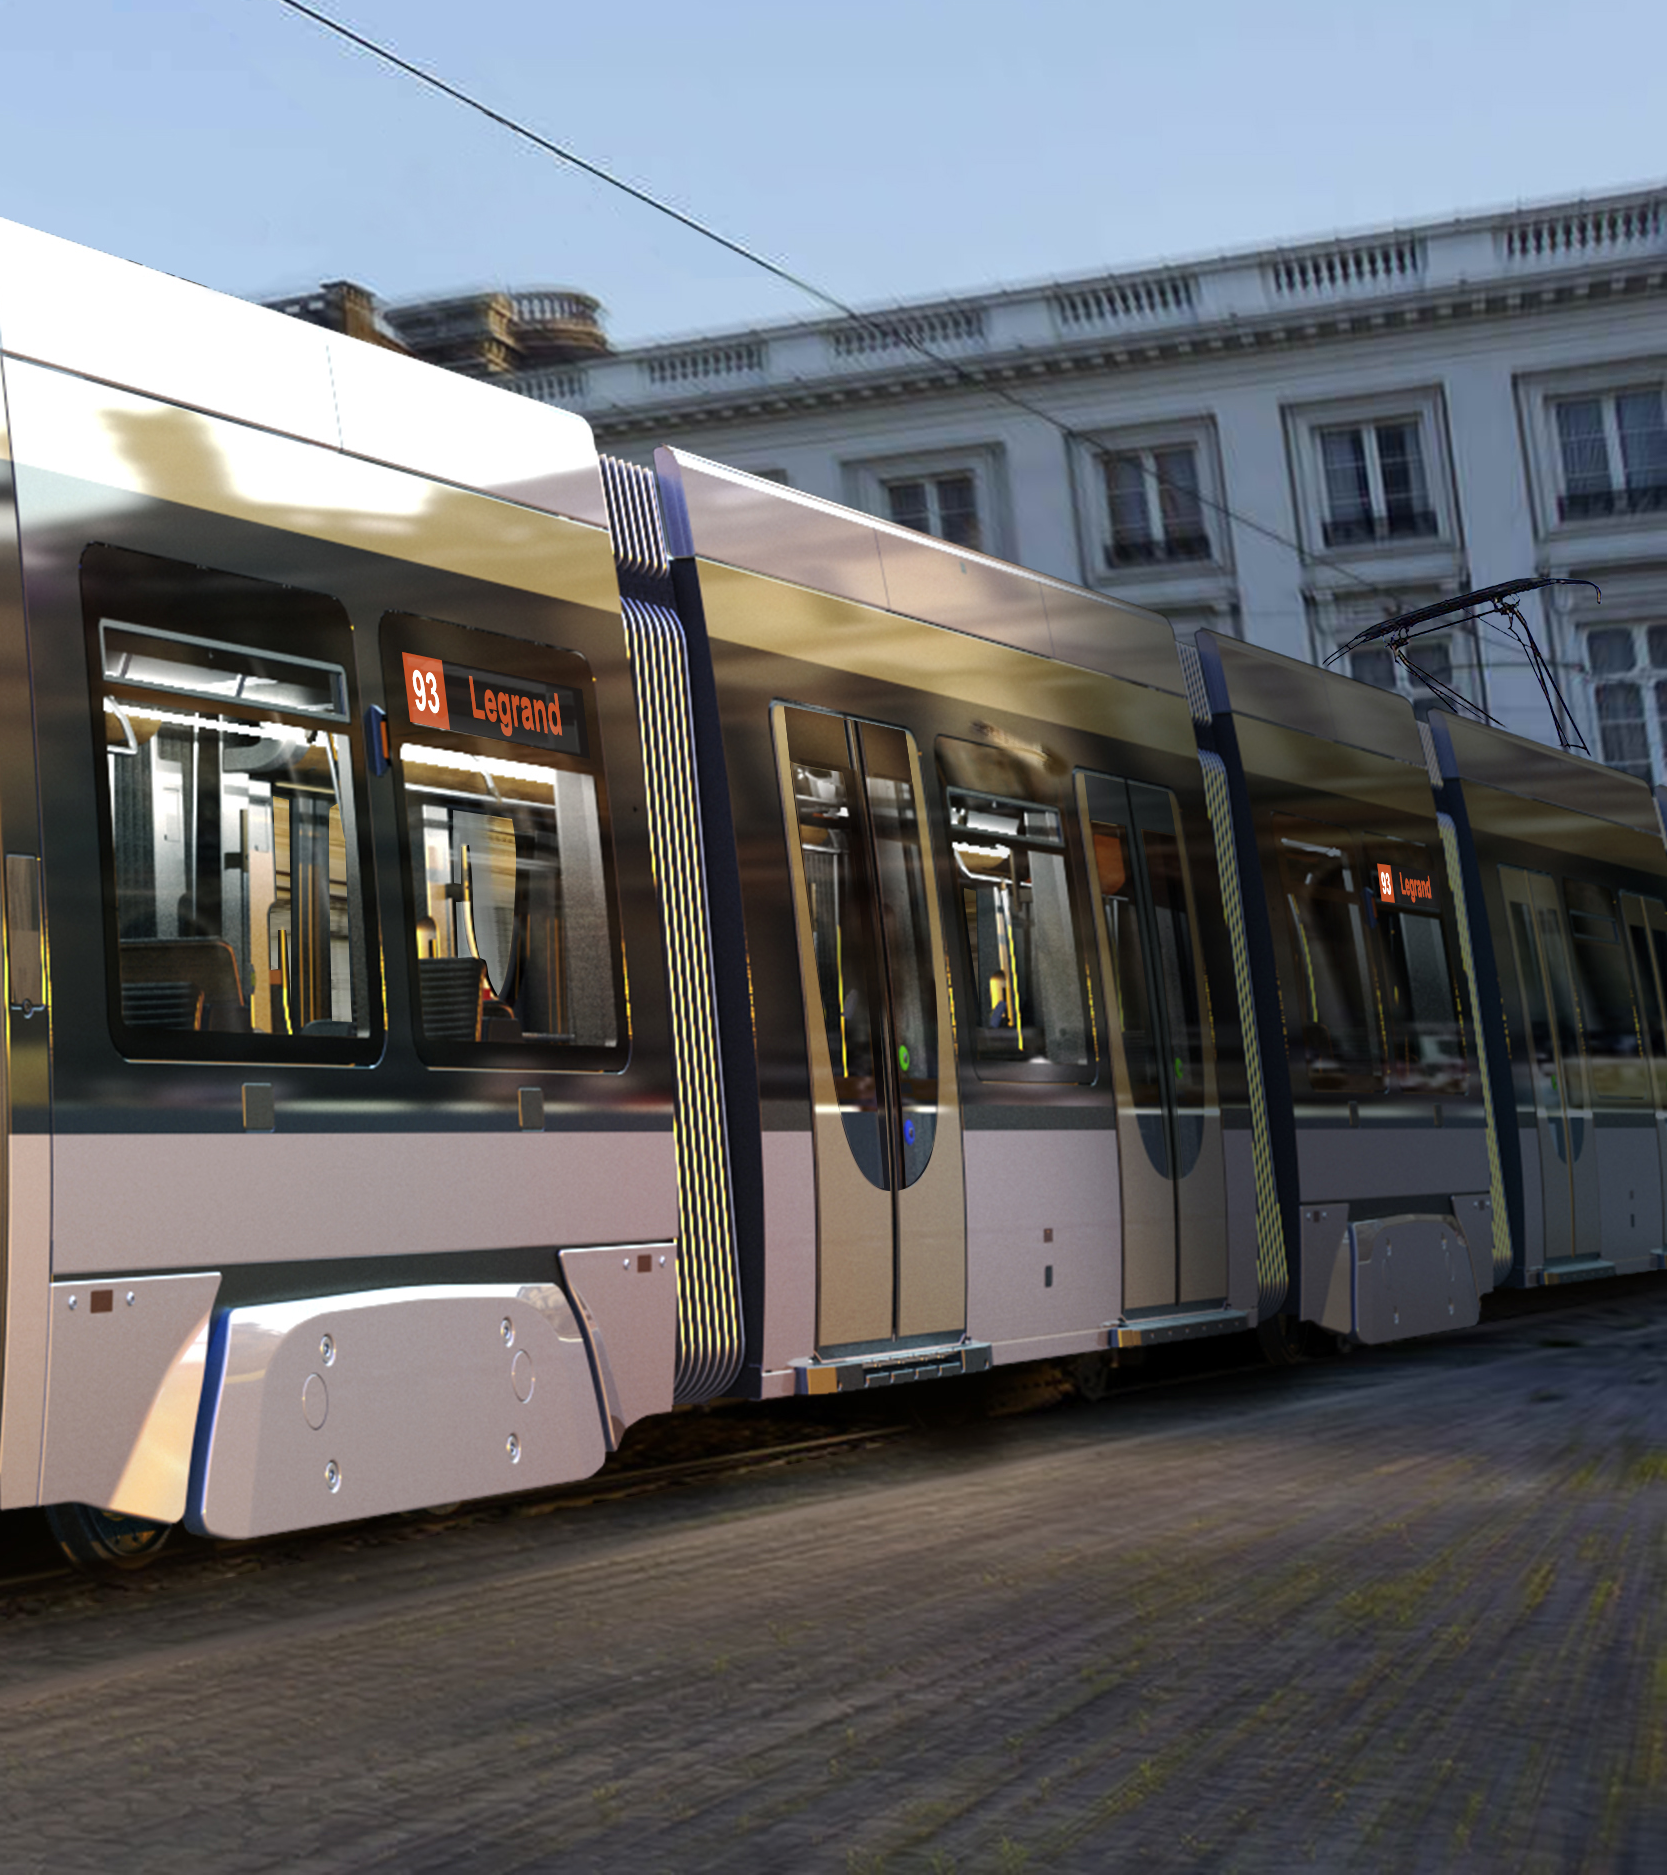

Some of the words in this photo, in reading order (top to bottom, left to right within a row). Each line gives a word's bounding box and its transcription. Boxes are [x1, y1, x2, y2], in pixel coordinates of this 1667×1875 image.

[412, 669, 441, 714] 93
[468, 675, 563, 737] Legrand
[1380, 871, 1392, 896] 93
[1399, 871, 1433, 904] Legrand
